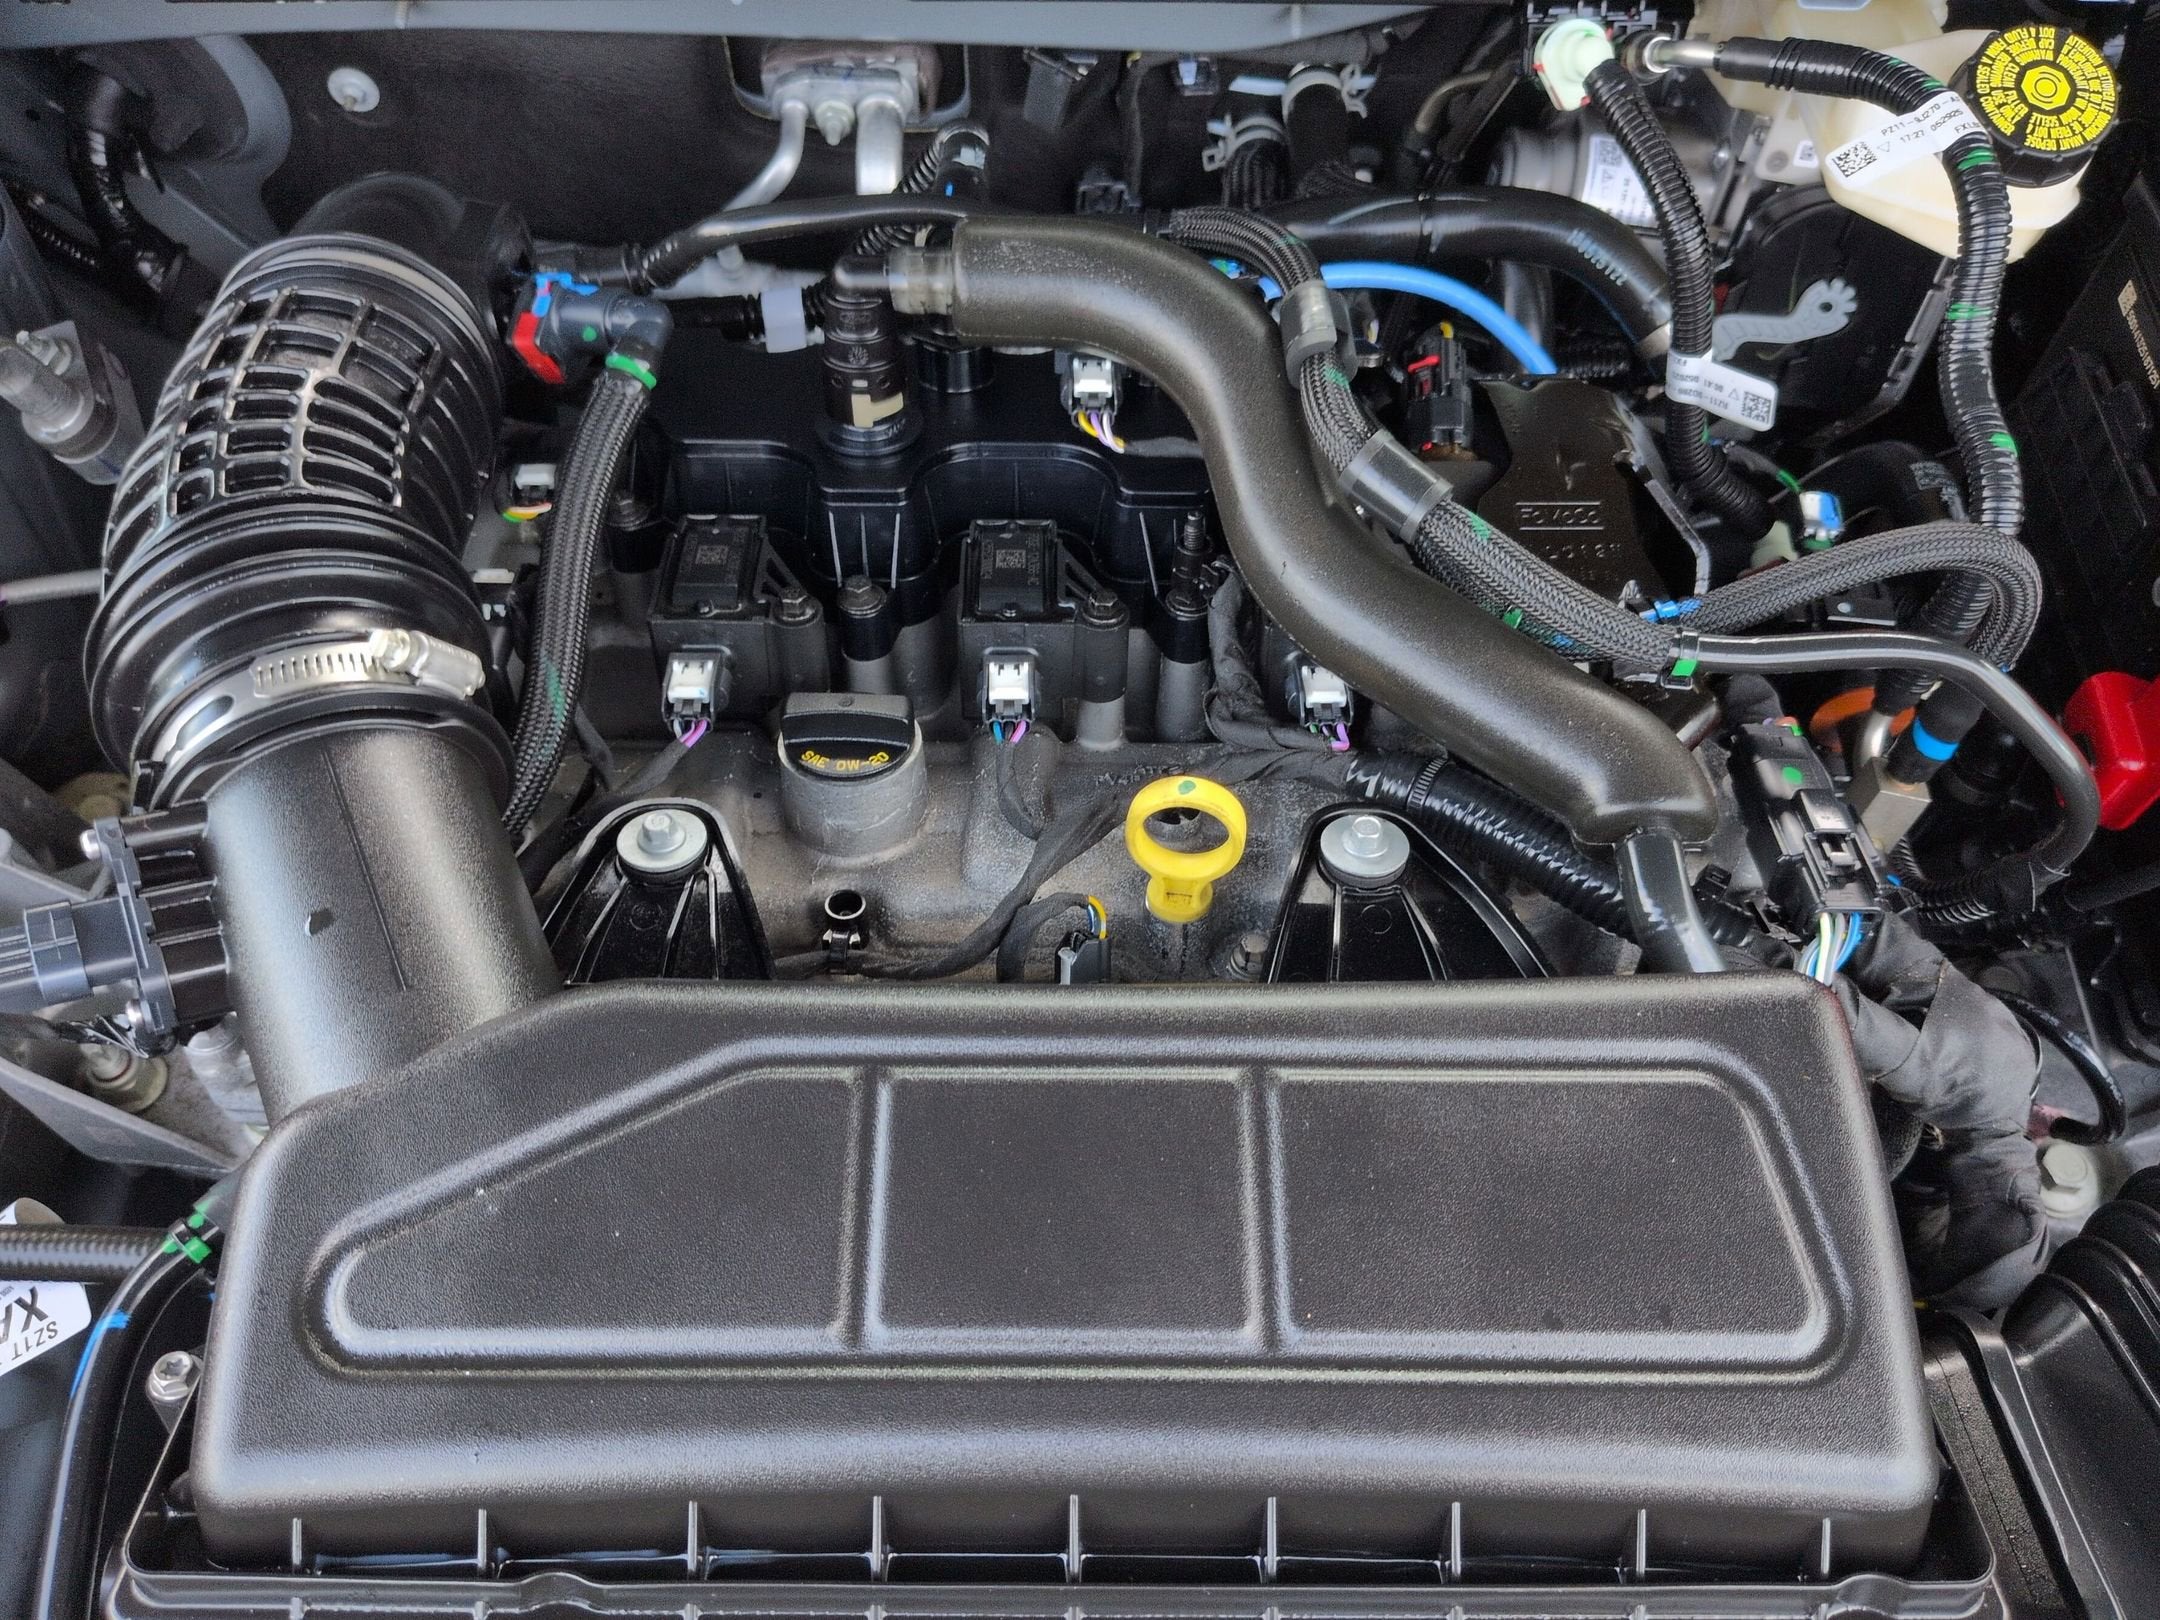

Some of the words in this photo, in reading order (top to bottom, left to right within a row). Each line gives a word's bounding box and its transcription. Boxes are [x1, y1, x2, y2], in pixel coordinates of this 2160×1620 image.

[2004, 27, 2028, 43] FLUID
[2039, 27, 2055, 37] DOT
[2006, 38, 2036, 56] BEFORE
[2039, 39, 2055, 49] CAP
[2066, 35, 2102, 65] ATTENTION
[1976, 65, 1990, 93] SEALED
[2003, 63, 2019, 87] CLEAN
[2097, 65, 2115, 101] NETTOYER
[1991, 90, 2003, 104] USE
[2005, 90, 2028, 119] FILLER
[1980, 96, 2015, 136] CONTAINER
[1999, 104, 2022, 124] ONLY
[2101, 102, 2114, 113] LE
[2033, 126, 2048, 138] DOT
[2070, 121, 2083, 134] DE
[2059, 134, 2084, 150] AVANT
[801, 750, 830, 768] SAE
